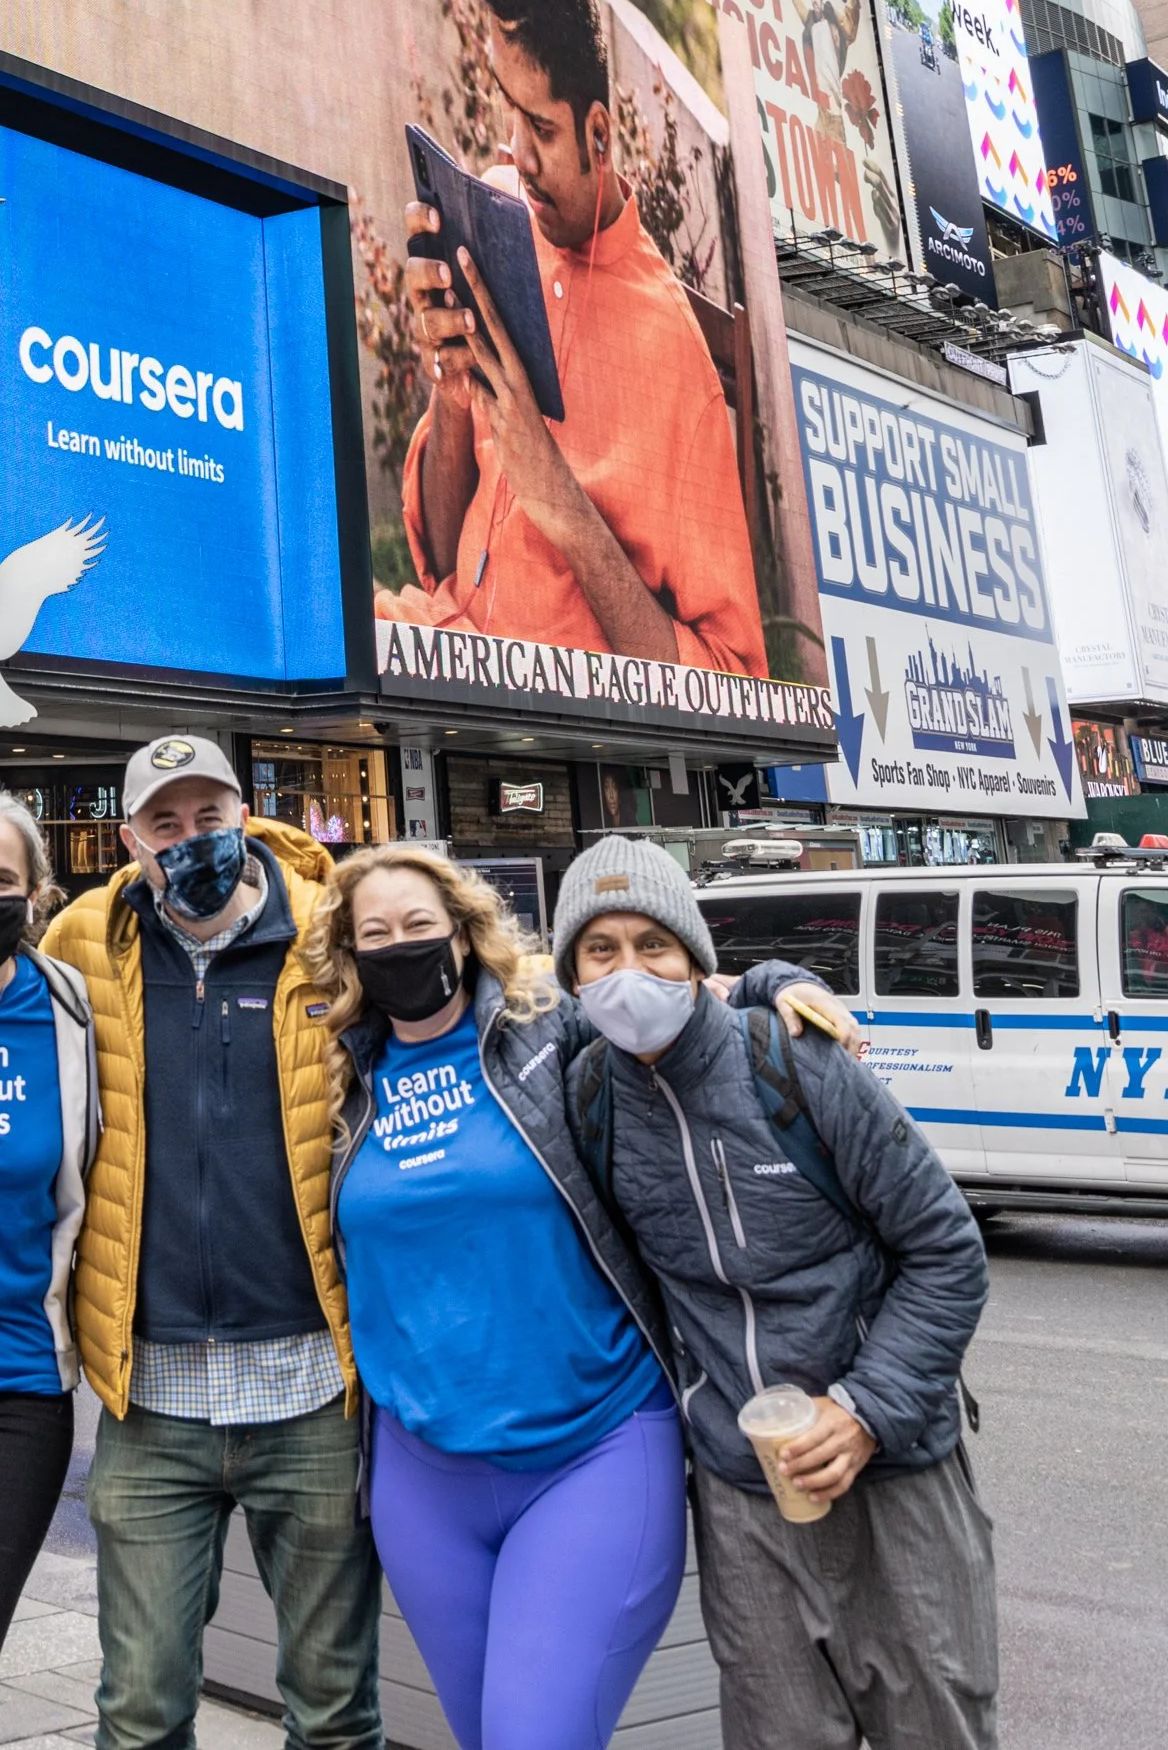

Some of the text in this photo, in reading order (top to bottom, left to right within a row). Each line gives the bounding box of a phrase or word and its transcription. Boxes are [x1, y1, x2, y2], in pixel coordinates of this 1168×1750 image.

[929, 237, 986, 277] ARCIMOTO
[18, 326, 244, 431] coursera
[48, 421, 225, 484] Learn without limits
[800, 377, 1030, 522] SUPPORT SMALL
[811, 460, 1046, 632] BUSINESS
[385, 625, 834, 729] AMERICAN EAGLE OUTFITTERS
[905, 680, 1013, 741] GRAND SLAM
[954, 741, 978, 752] NEW YORK
[1141, 738, 1168, 765] BLUE
[871, 758, 1056, 797] Sports Fan Shop NYC Apparel Souvenirs
[518, 1042, 556, 1082] coursera
[858, 1042, 919, 1056] COURTESY
[859, 1060, 954, 1072] OFESSIONALISM
[382, 1064, 457, 1104] Learn
[1065, 1047, 1168, 1099] NY
[374, 1080, 475, 1137] without
[384, 1118, 459, 1151] limits
[399, 1149, 445, 1170] coursera
[754, 1161, 797, 1174] course
